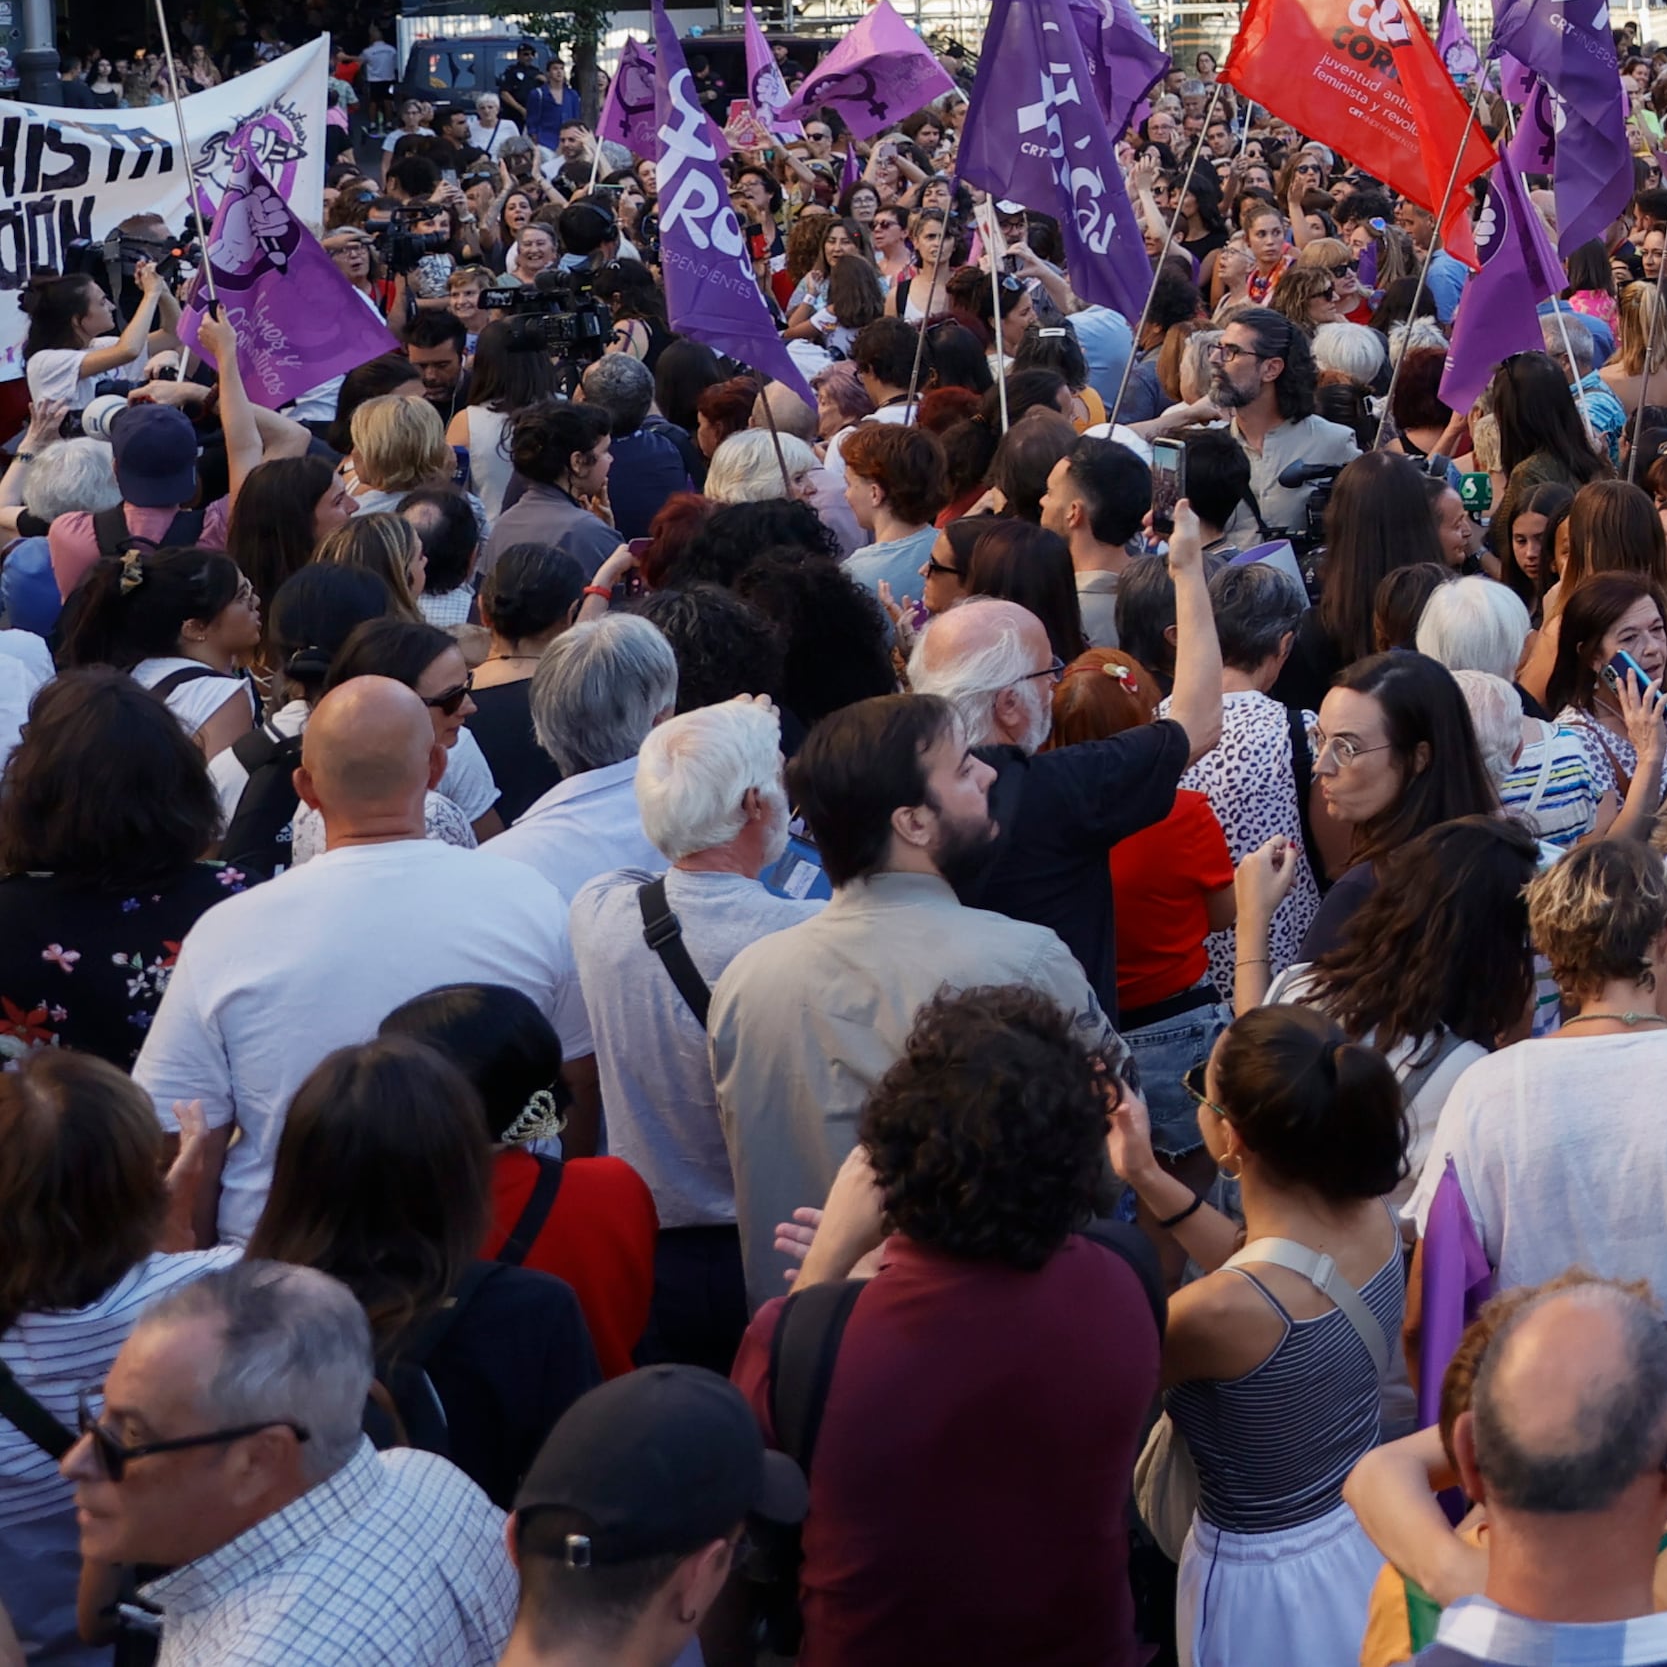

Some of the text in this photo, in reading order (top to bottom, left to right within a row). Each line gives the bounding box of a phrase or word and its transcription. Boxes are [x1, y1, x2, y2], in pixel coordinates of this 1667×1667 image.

[1312, 65, 1368, 105] feminista
[1368, 100, 1380, 113] y
[1319, 51, 1383, 93] juventud
